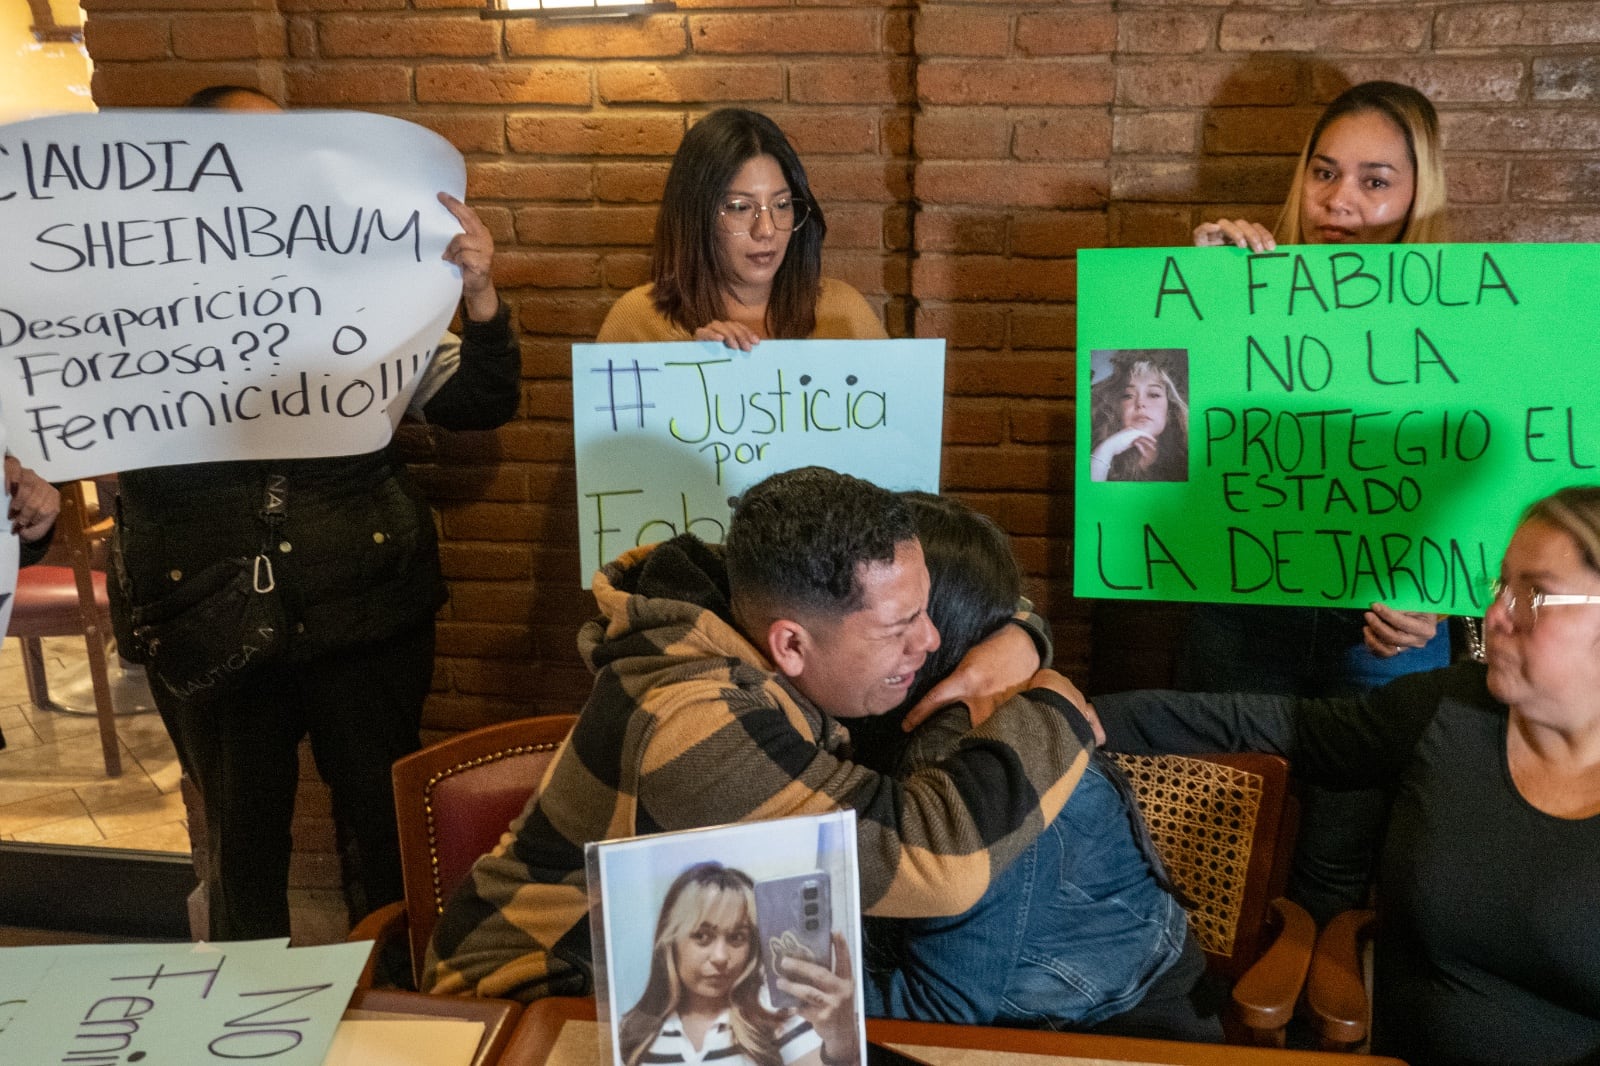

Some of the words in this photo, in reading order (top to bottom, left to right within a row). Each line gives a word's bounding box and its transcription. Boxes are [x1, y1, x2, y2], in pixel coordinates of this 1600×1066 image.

[30, 204, 423, 273] SHEINBAUM
[1154, 255, 1204, 321] A
[1246, 249, 1519, 315] FABIOLA
[15, 322, 290, 397] Forzosa??
[1246, 334, 1334, 393] NO
[1366, 327, 1460, 385] LA
[699, 441, 771, 487] por
[1203, 406, 1492, 474] PROTEGIO
[1525, 406, 1597, 469] EL
[1221, 472, 1423, 515] ESTADO
[1096, 521, 1198, 591] LA
[61, 954, 227, 1066] Femi
[207, 982, 334, 1059] NO
